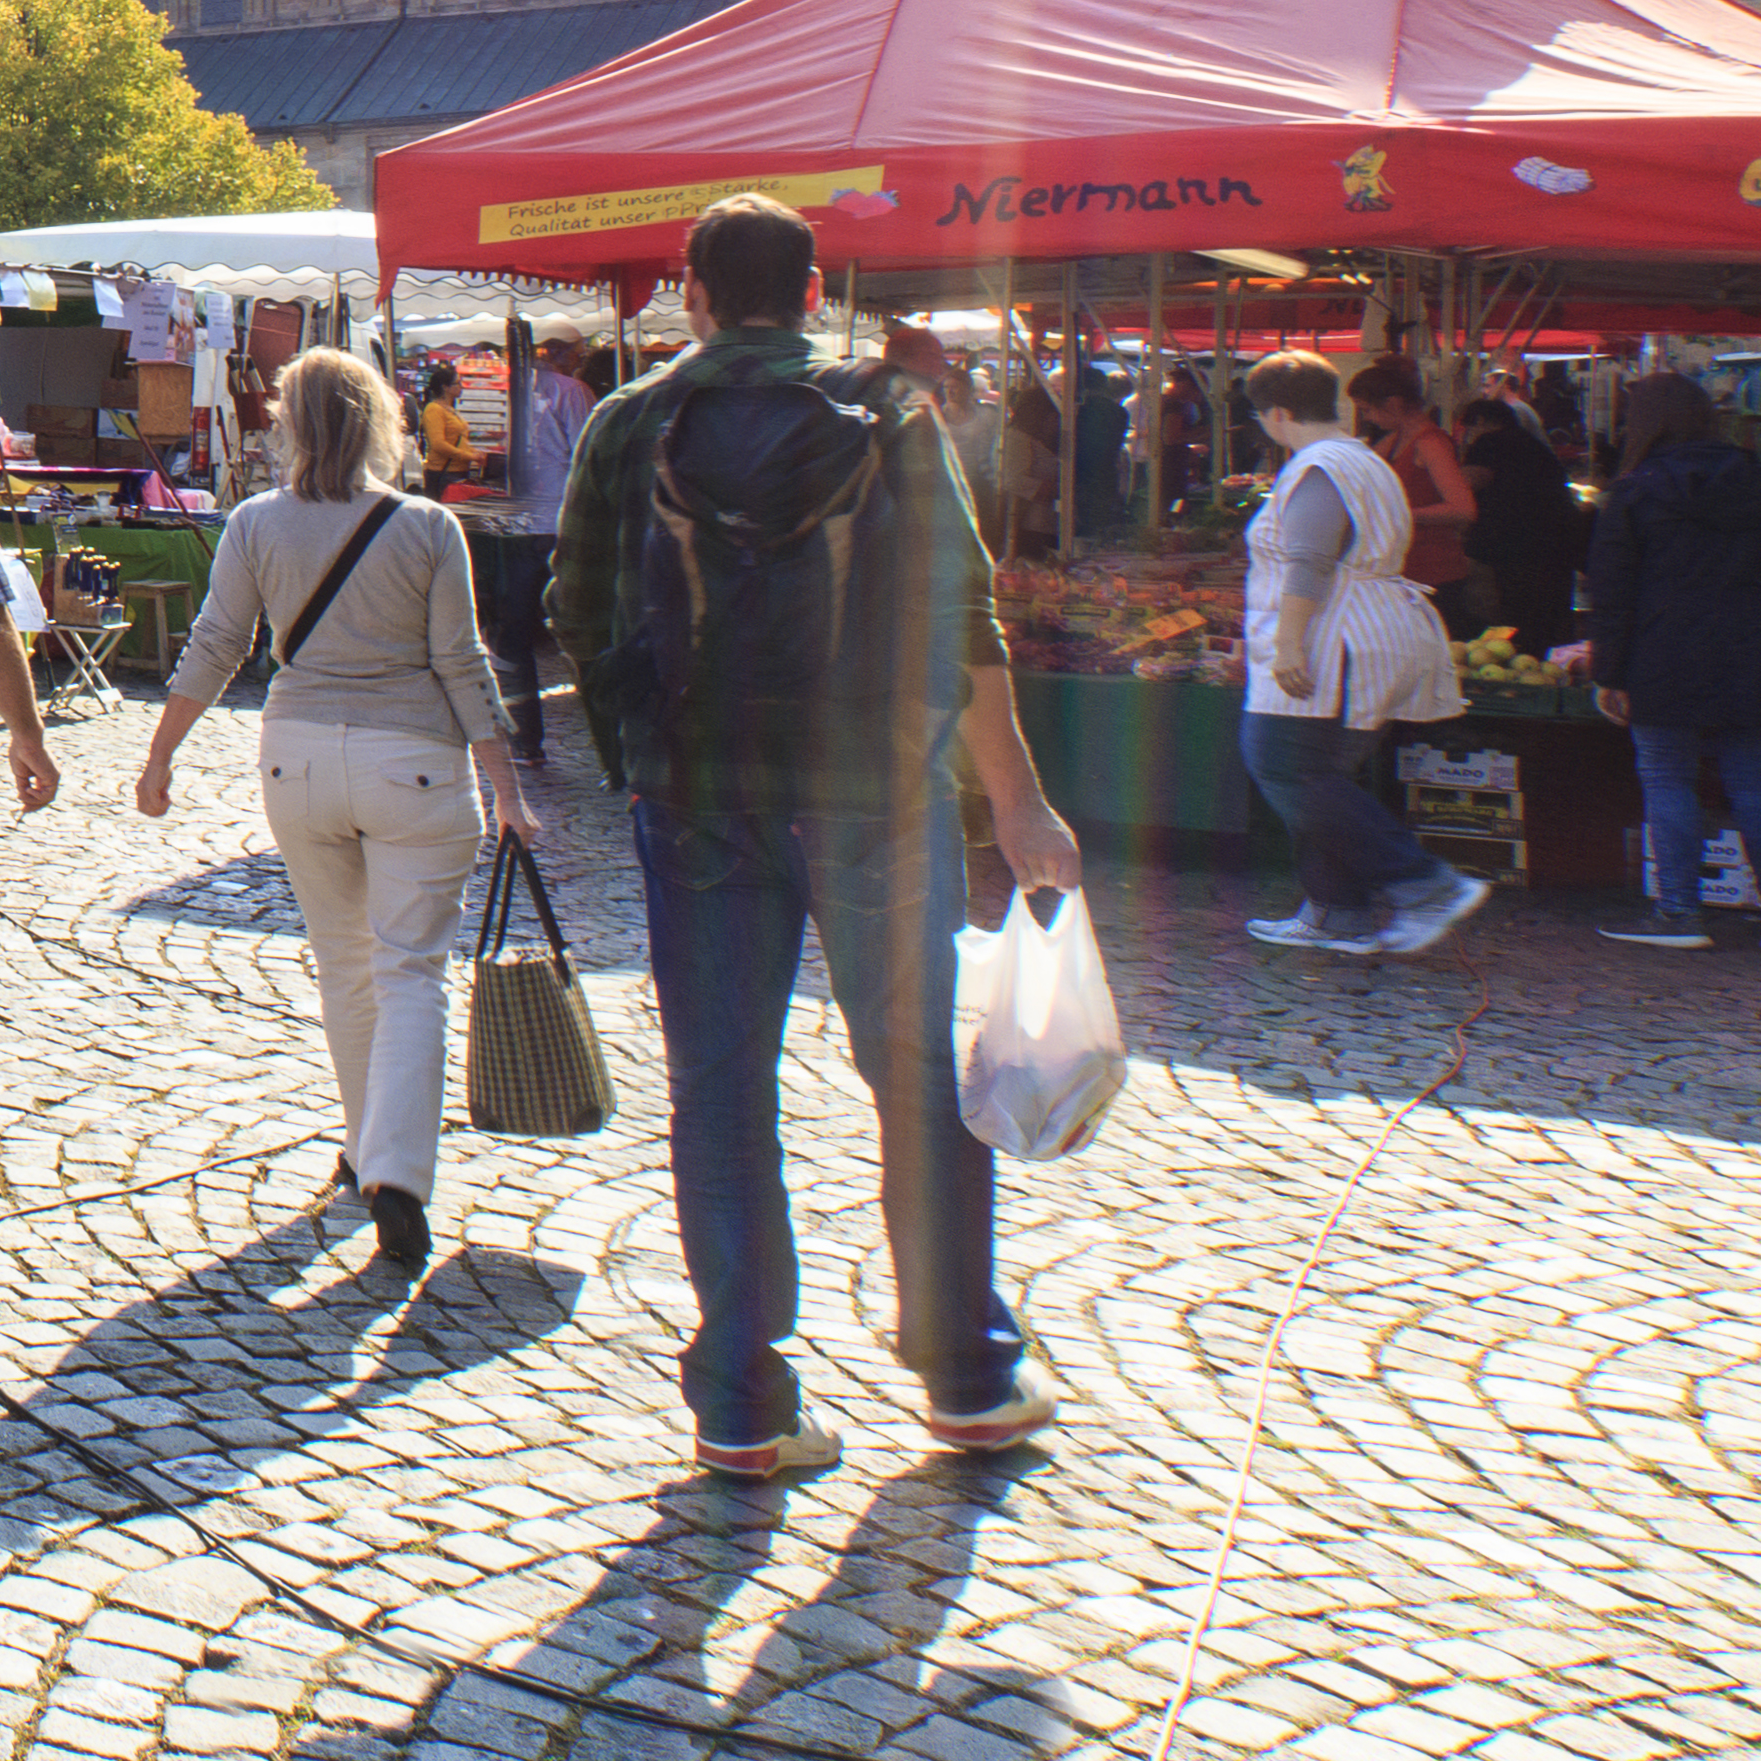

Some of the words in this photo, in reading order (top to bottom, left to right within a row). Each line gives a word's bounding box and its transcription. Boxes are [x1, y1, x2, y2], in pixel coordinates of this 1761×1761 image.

[508, 201, 576, 219] Frische
[585, 196, 610, 211] ist
[618, 190, 685, 207] unsere
[936, 175, 1263, 226] Niermann
[509, 215, 592, 237] Qualität
[599, 211, 656, 227] unser
